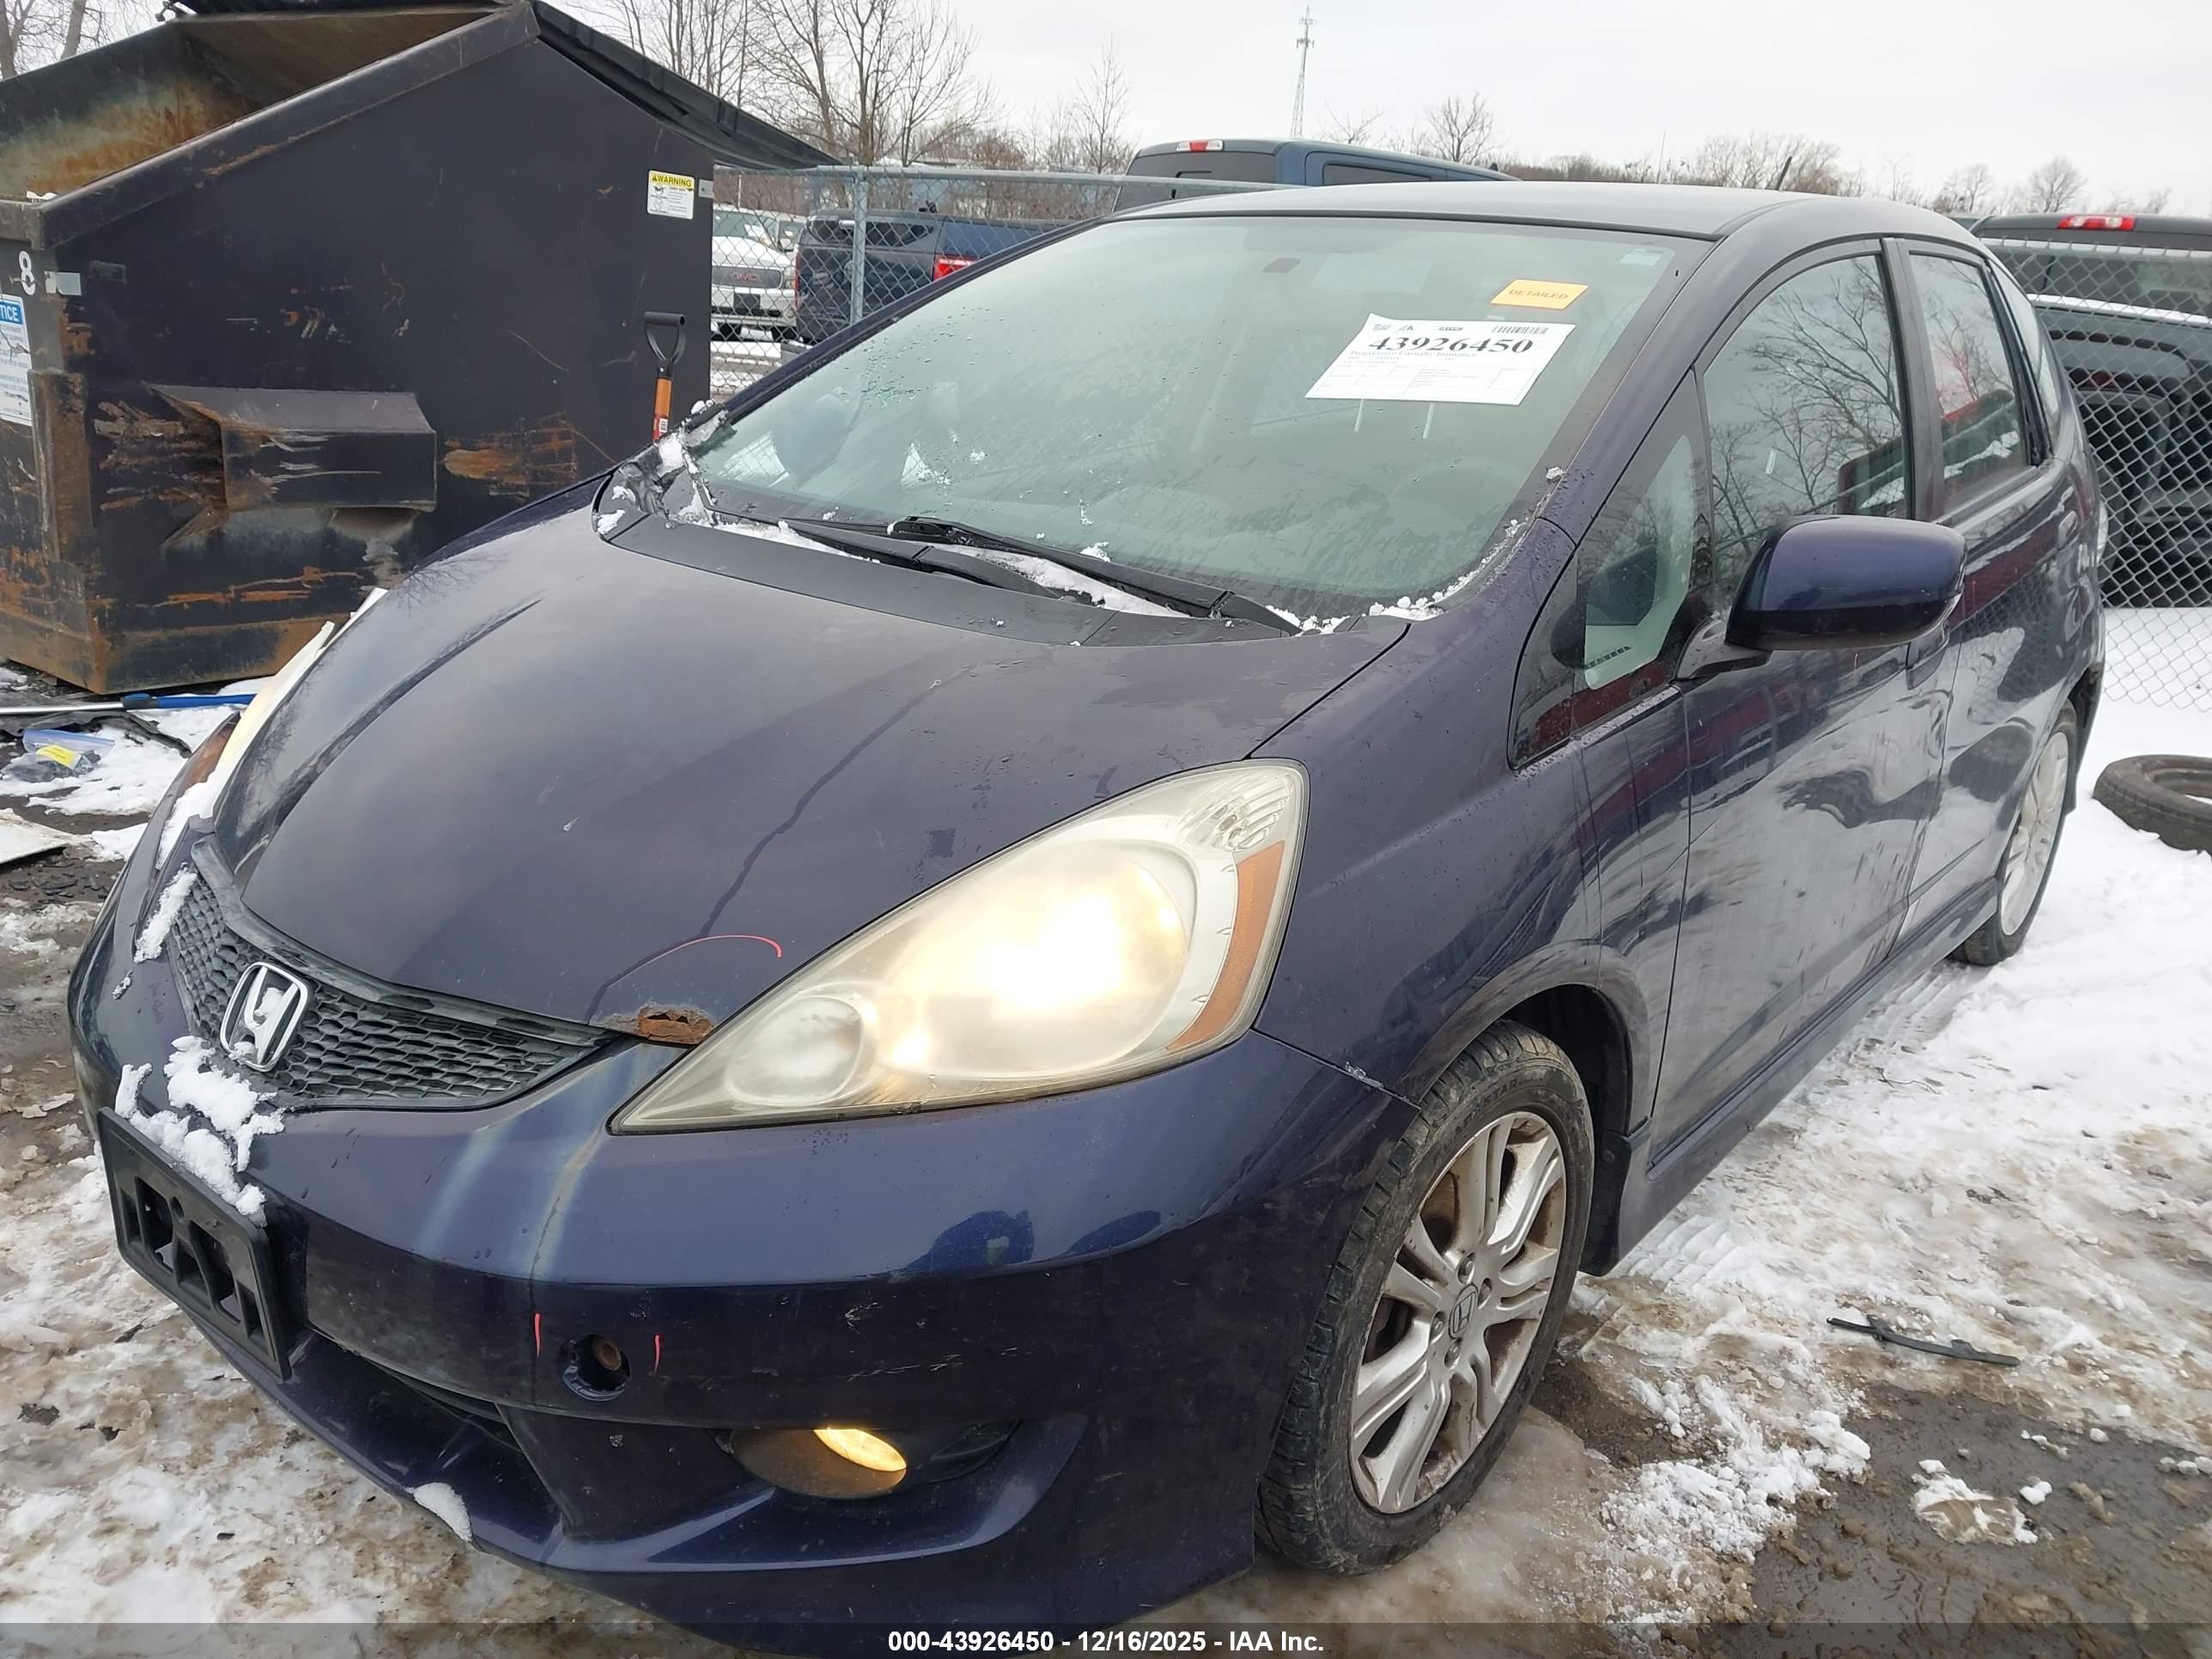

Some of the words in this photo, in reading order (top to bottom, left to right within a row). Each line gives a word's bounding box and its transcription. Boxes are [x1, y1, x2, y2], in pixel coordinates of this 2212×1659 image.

[657, 174, 691, 187] WARNING
[19, 251, 35, 295] 8
[1369, 337, 1534, 354] 43926450
